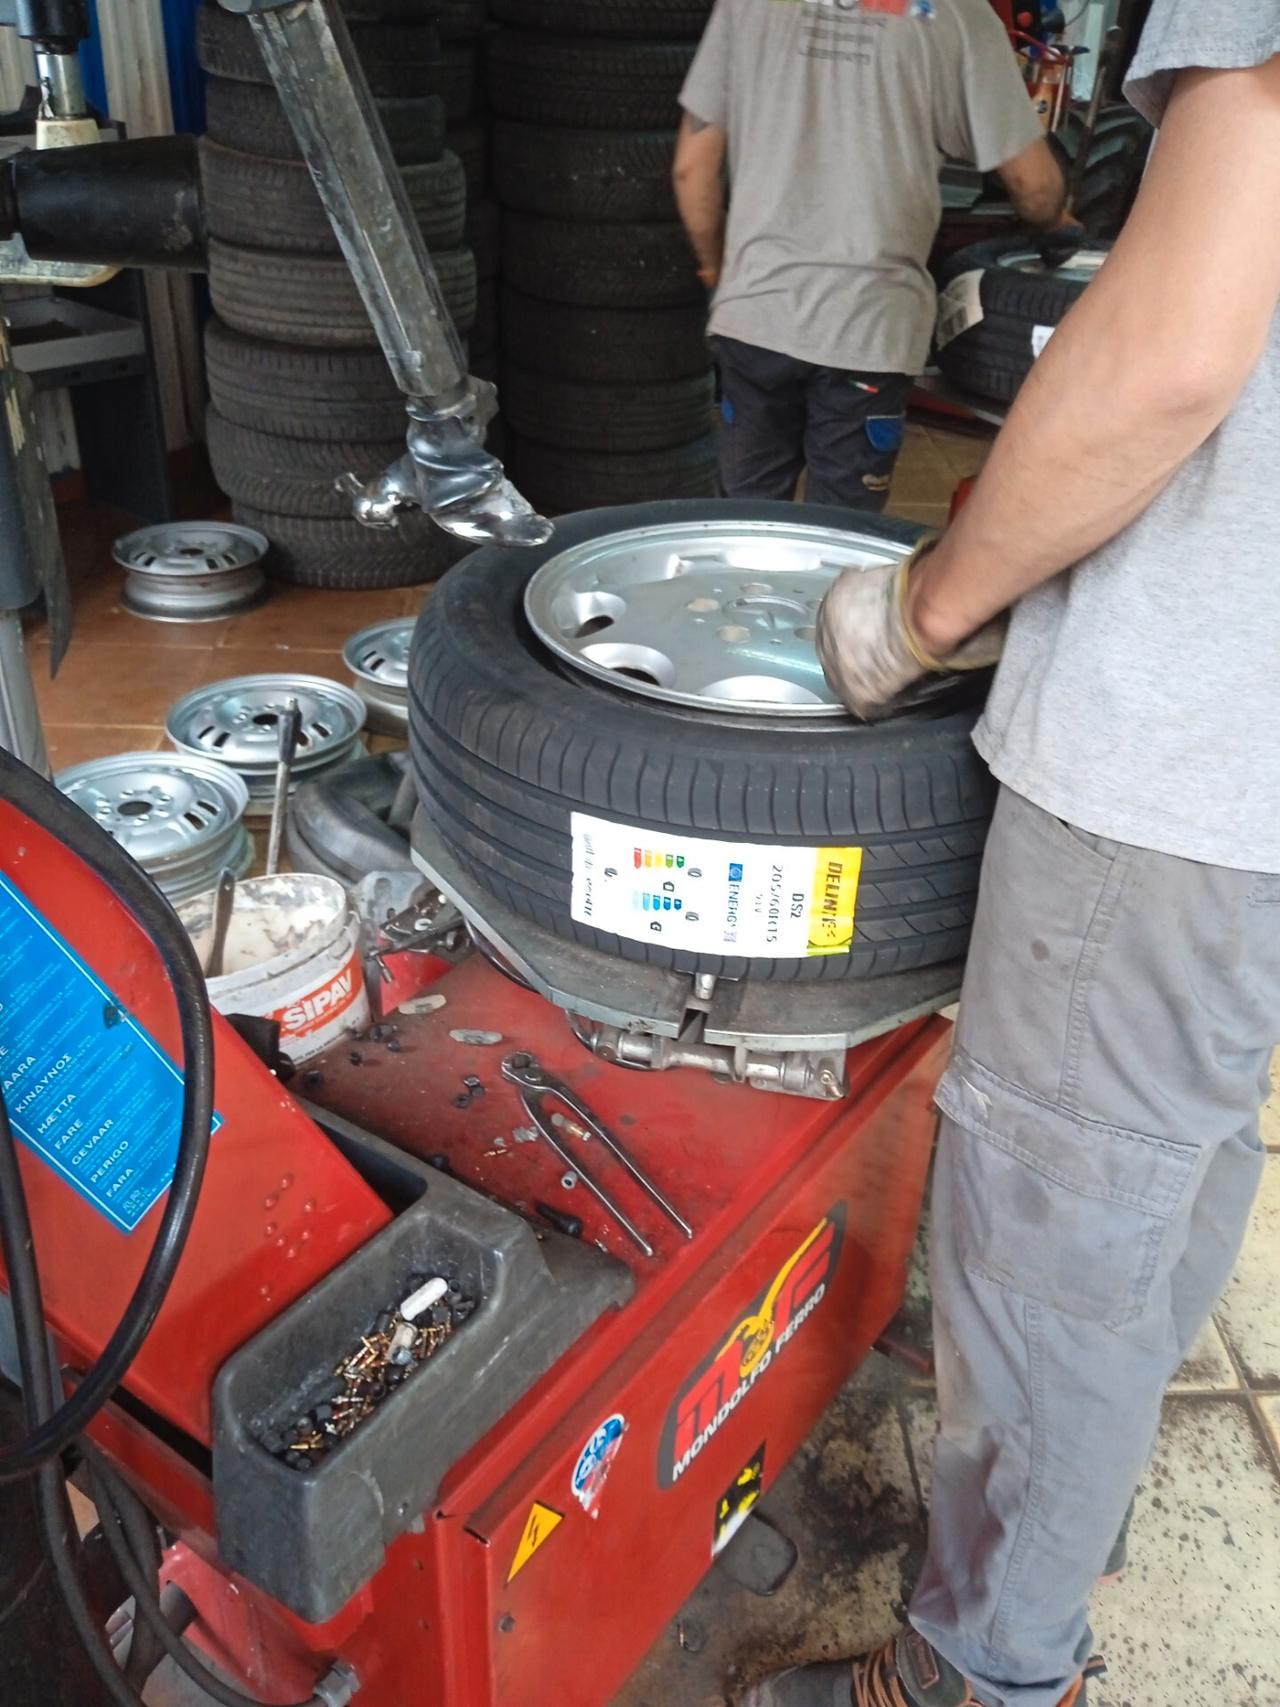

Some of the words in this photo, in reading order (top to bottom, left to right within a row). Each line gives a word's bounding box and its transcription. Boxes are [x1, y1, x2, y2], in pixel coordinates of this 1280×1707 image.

[790, 892, 805, 919] DS2
[54, 1119, 83, 1149] FARE
[71, 1119, 114, 1165] GEVAAR
[90, 1141, 129, 1183] PERIGO
[106, 1168, 134, 1198] FARA
[673, 1350, 771, 1481] MONDOLFO
[775, 1283, 825, 1354] FERRO
